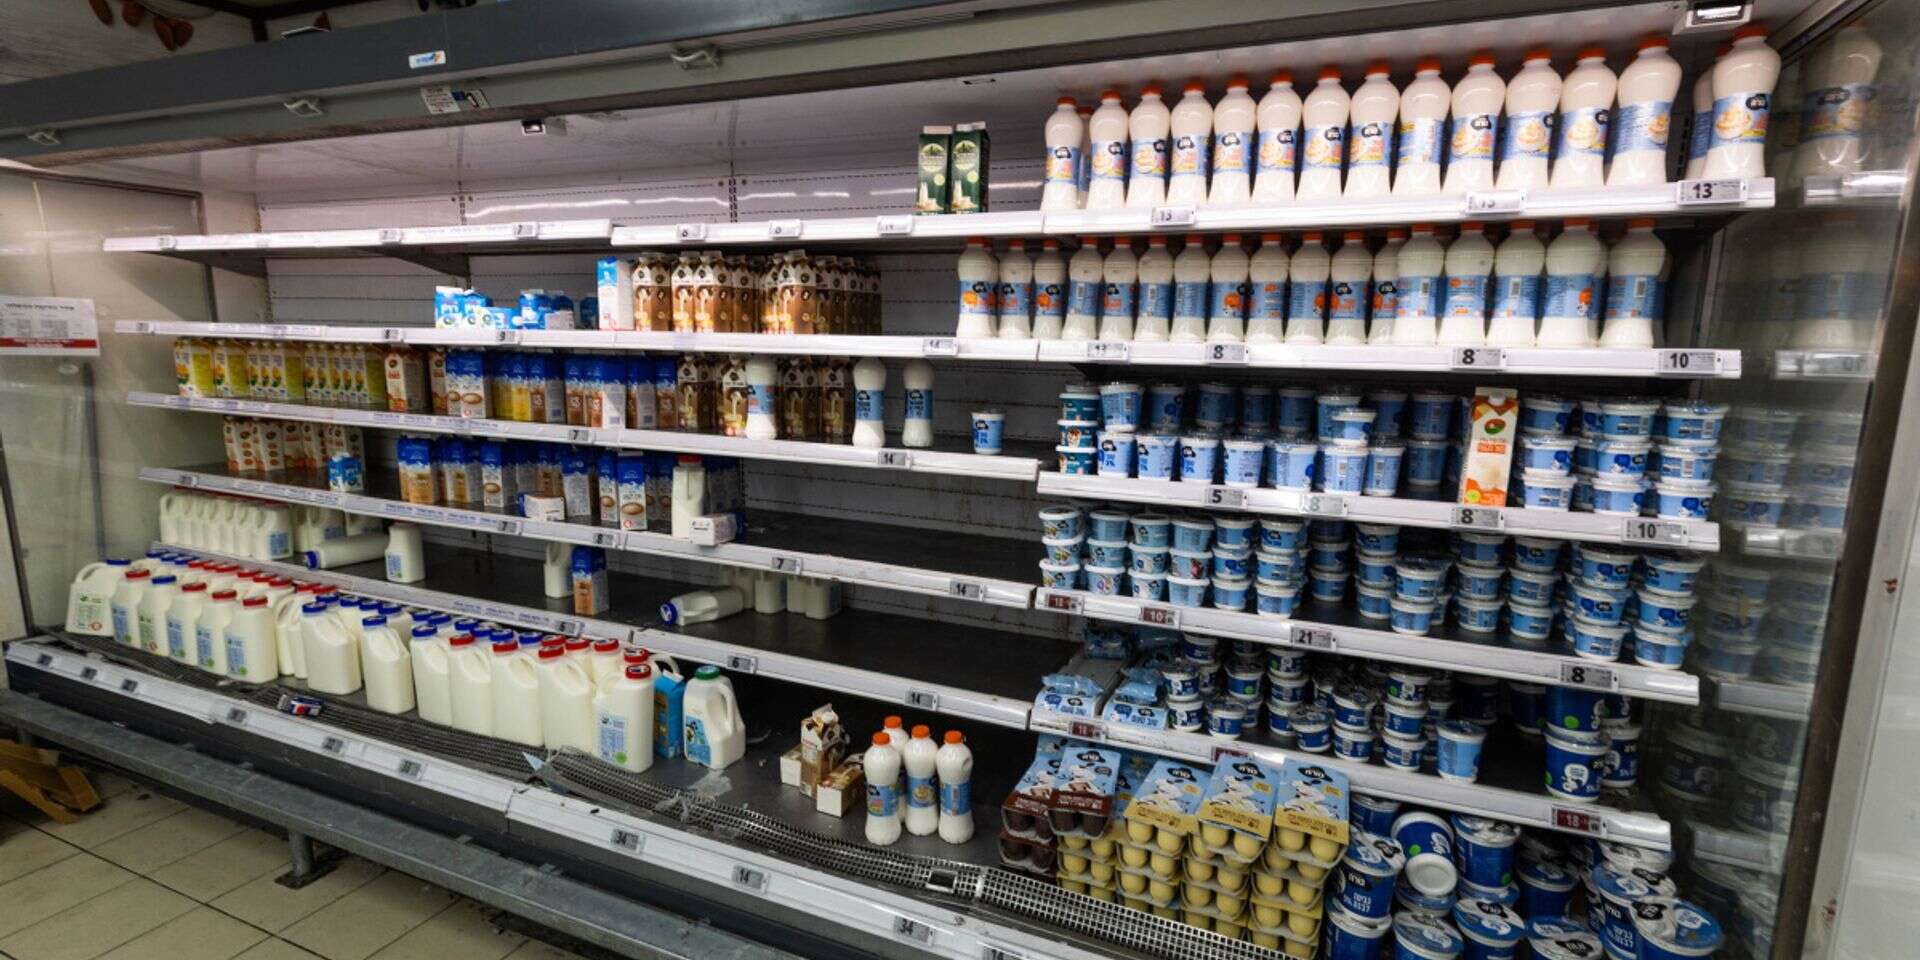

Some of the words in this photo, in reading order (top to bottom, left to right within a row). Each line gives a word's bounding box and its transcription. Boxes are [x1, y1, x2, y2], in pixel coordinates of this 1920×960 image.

[1692, 183, 1712, 199] 13
[1213, 345, 1223, 359] 8
[1462, 349, 1475, 364] 8
[1670, 353, 1689, 369] 10
[573, 430, 580, 441] 7
[884, 453, 894, 464] 14
[1212, 489, 1222, 504] 5
[1309, 496, 1320, 511] 8
[1461, 509, 1474, 524] 8
[502, 521, 508, 531] 7
[1638, 523, 1657, 539] 10
[777, 558, 785, 569] 7
[956, 583, 967, 596] 14
[1151, 610, 1163, 623] 10
[1299, 630, 1312, 644] 21
[733, 657, 740, 668] 6
[1571, 667, 1585, 683] 8
[911, 692, 921, 705] 14
[740, 868, 749, 883] 14
[1348, 873, 1366, 887] טרה
[900, 918, 914, 936] 34
